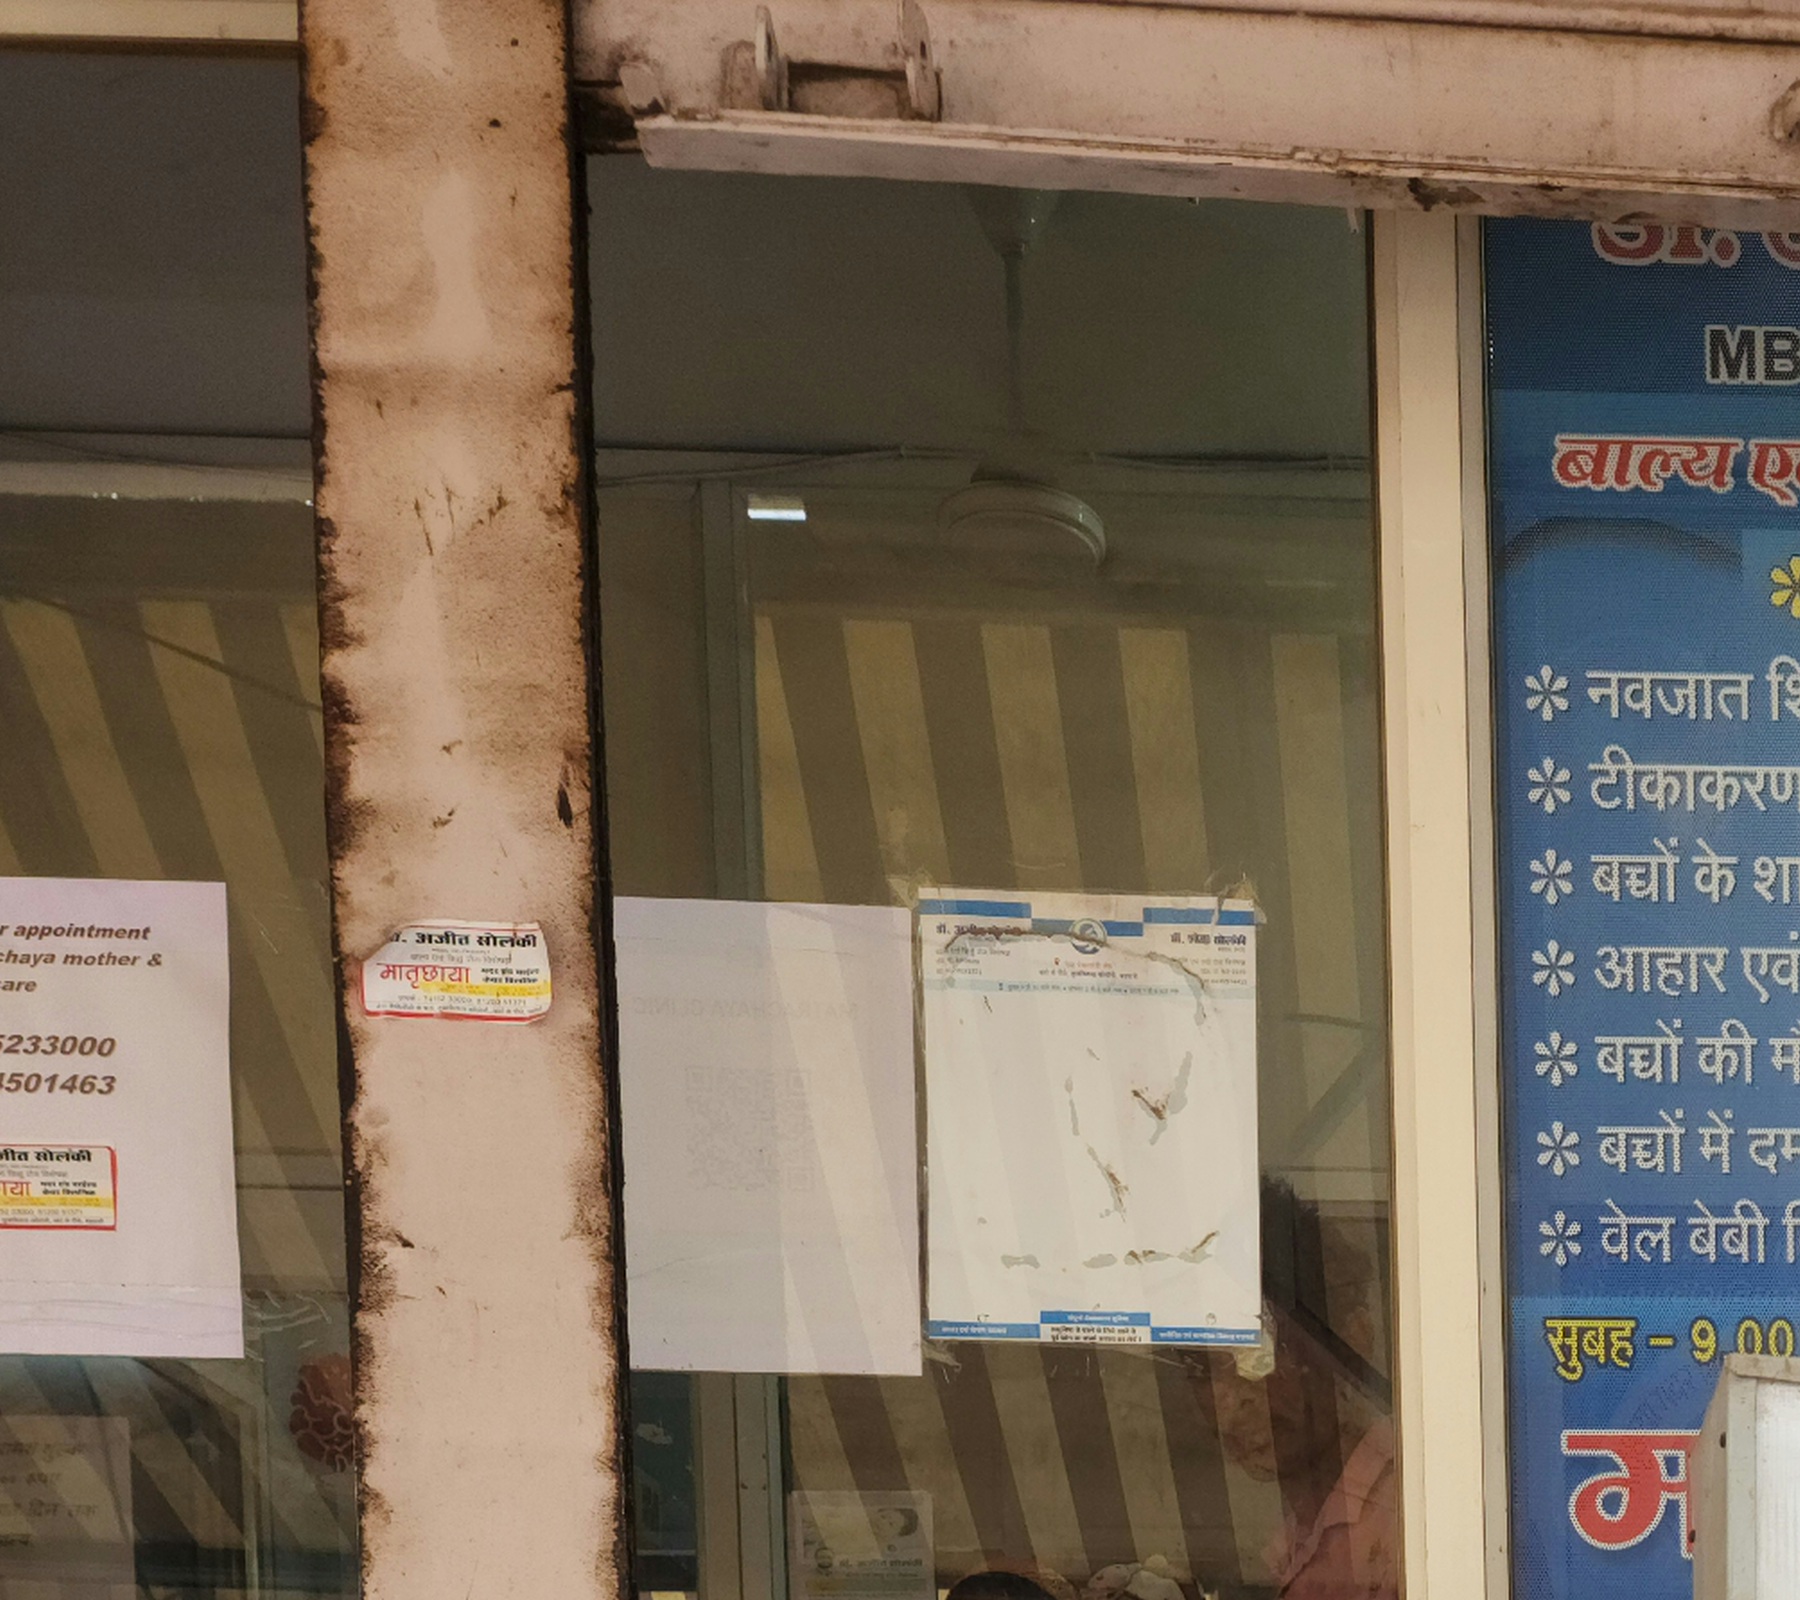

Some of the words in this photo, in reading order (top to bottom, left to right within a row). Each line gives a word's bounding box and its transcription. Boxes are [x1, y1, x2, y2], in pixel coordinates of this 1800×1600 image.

[1552, 432, 1744, 492] बाल्य
[1586, 672, 1754, 722] नवजात
[1692, 838, 1739, 904] के
[14, 923, 151, 940] appointment
[62, 952, 141, 966] mother
[147, 953, 162, 967] &
[415, 930, 470, 946] अजीत
[476, 932, 537, 948] सोलंकी
[1595, 946, 1728, 997] आहार
[1696, 1019, 1757, 1085] की
[1699, 1110, 1738, 1175] में
[1599, 1199, 1675, 1265] वेल
[1688, 1201, 1769, 1265] बेबी
[1545, 1316, 1637, 1381] सुबह
